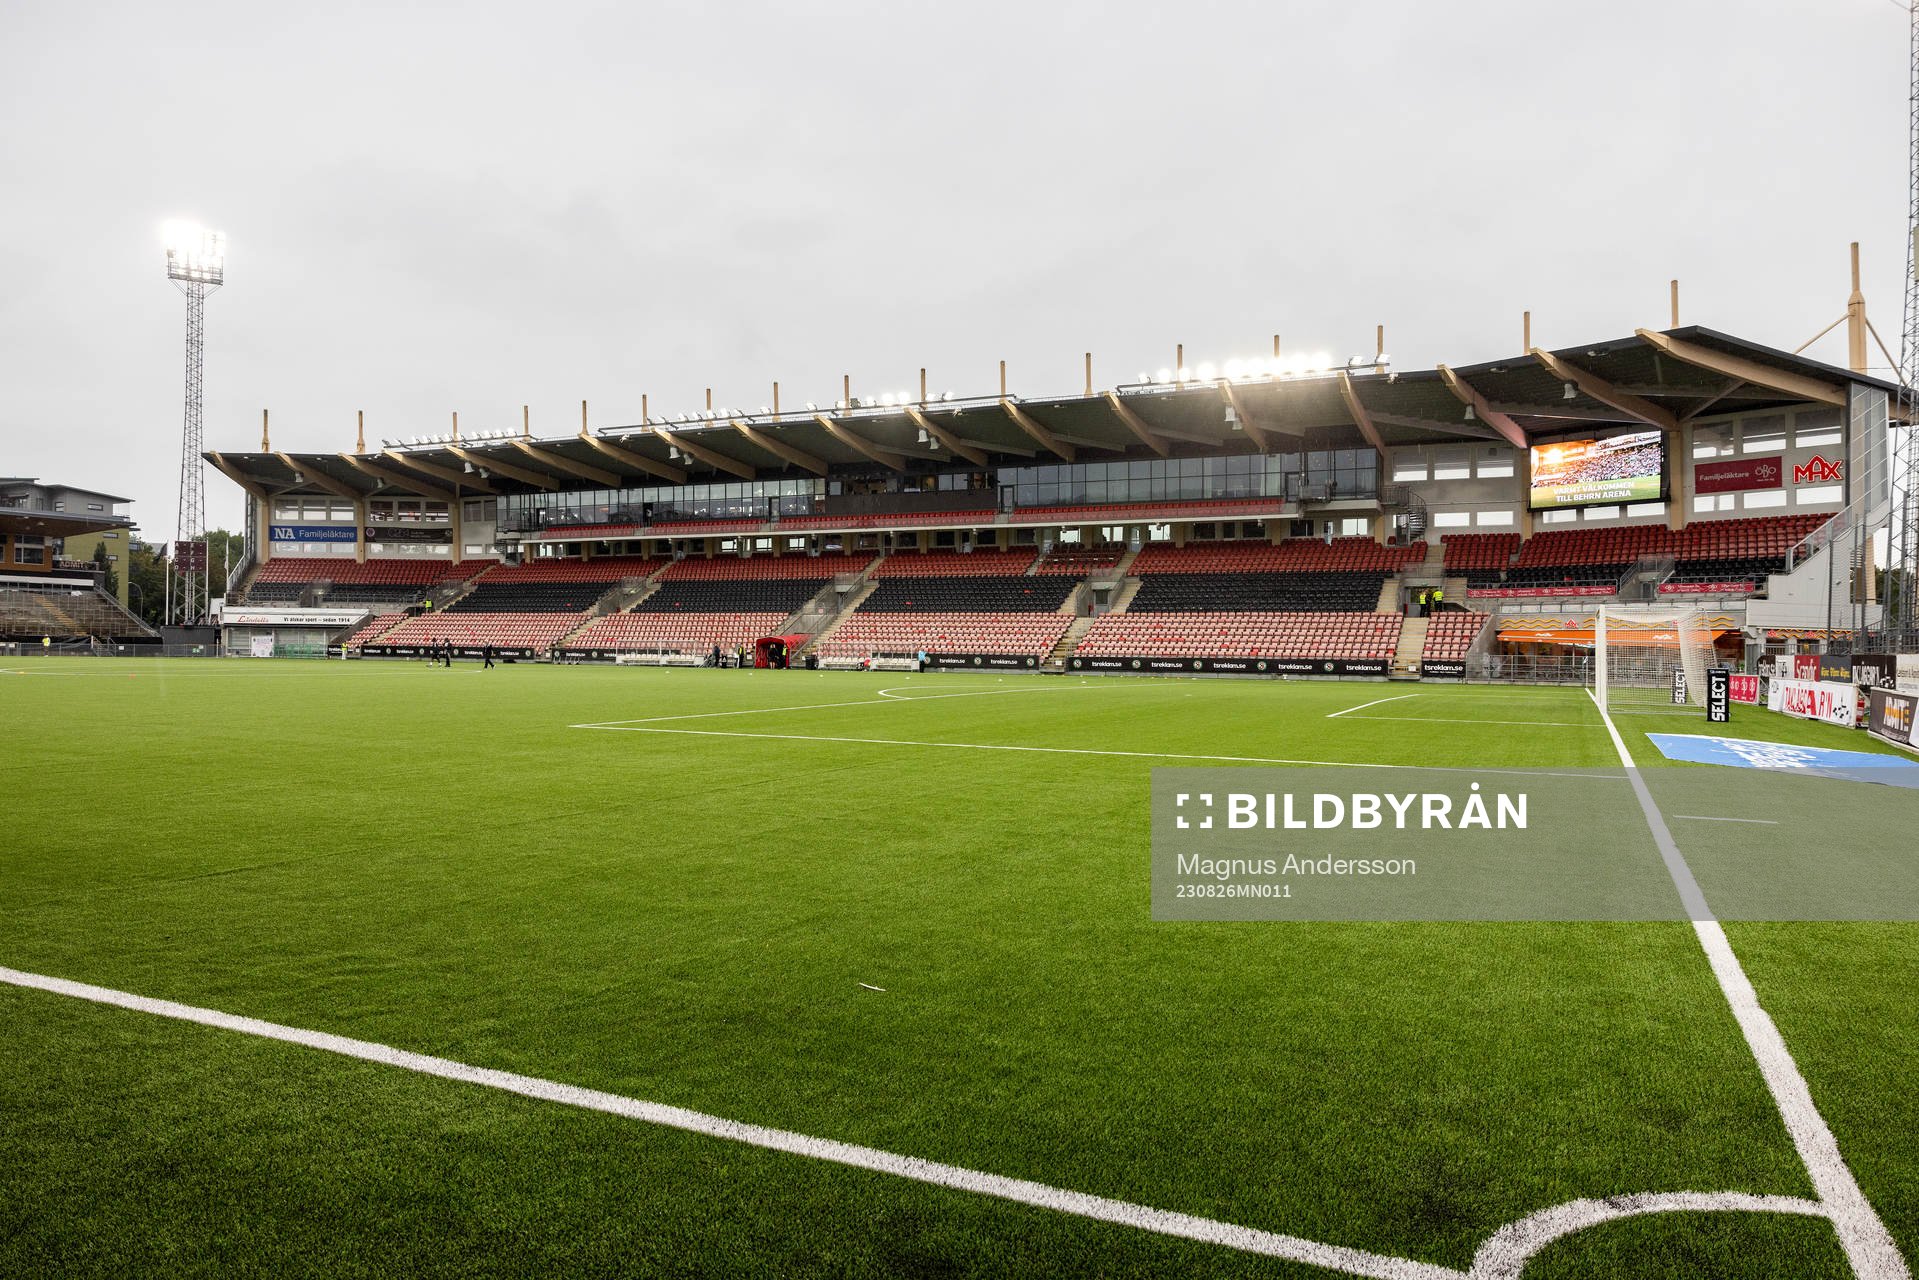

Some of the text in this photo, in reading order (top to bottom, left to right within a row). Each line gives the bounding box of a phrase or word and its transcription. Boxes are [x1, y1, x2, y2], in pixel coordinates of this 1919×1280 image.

[1793, 455, 1844, 484] MAX
[1699, 472, 1750, 481] Familjeläktare
[1574, 492, 1601, 501] BEHRN
[1602, 489, 1632, 499] ARENA
[274, 527, 355, 540] NA Familjeläktare
[1424, 664, 1464, 672] tsreklam.se
[1675, 671, 1686, 704] SELECT
[1711, 676, 1726, 722] SELECT
